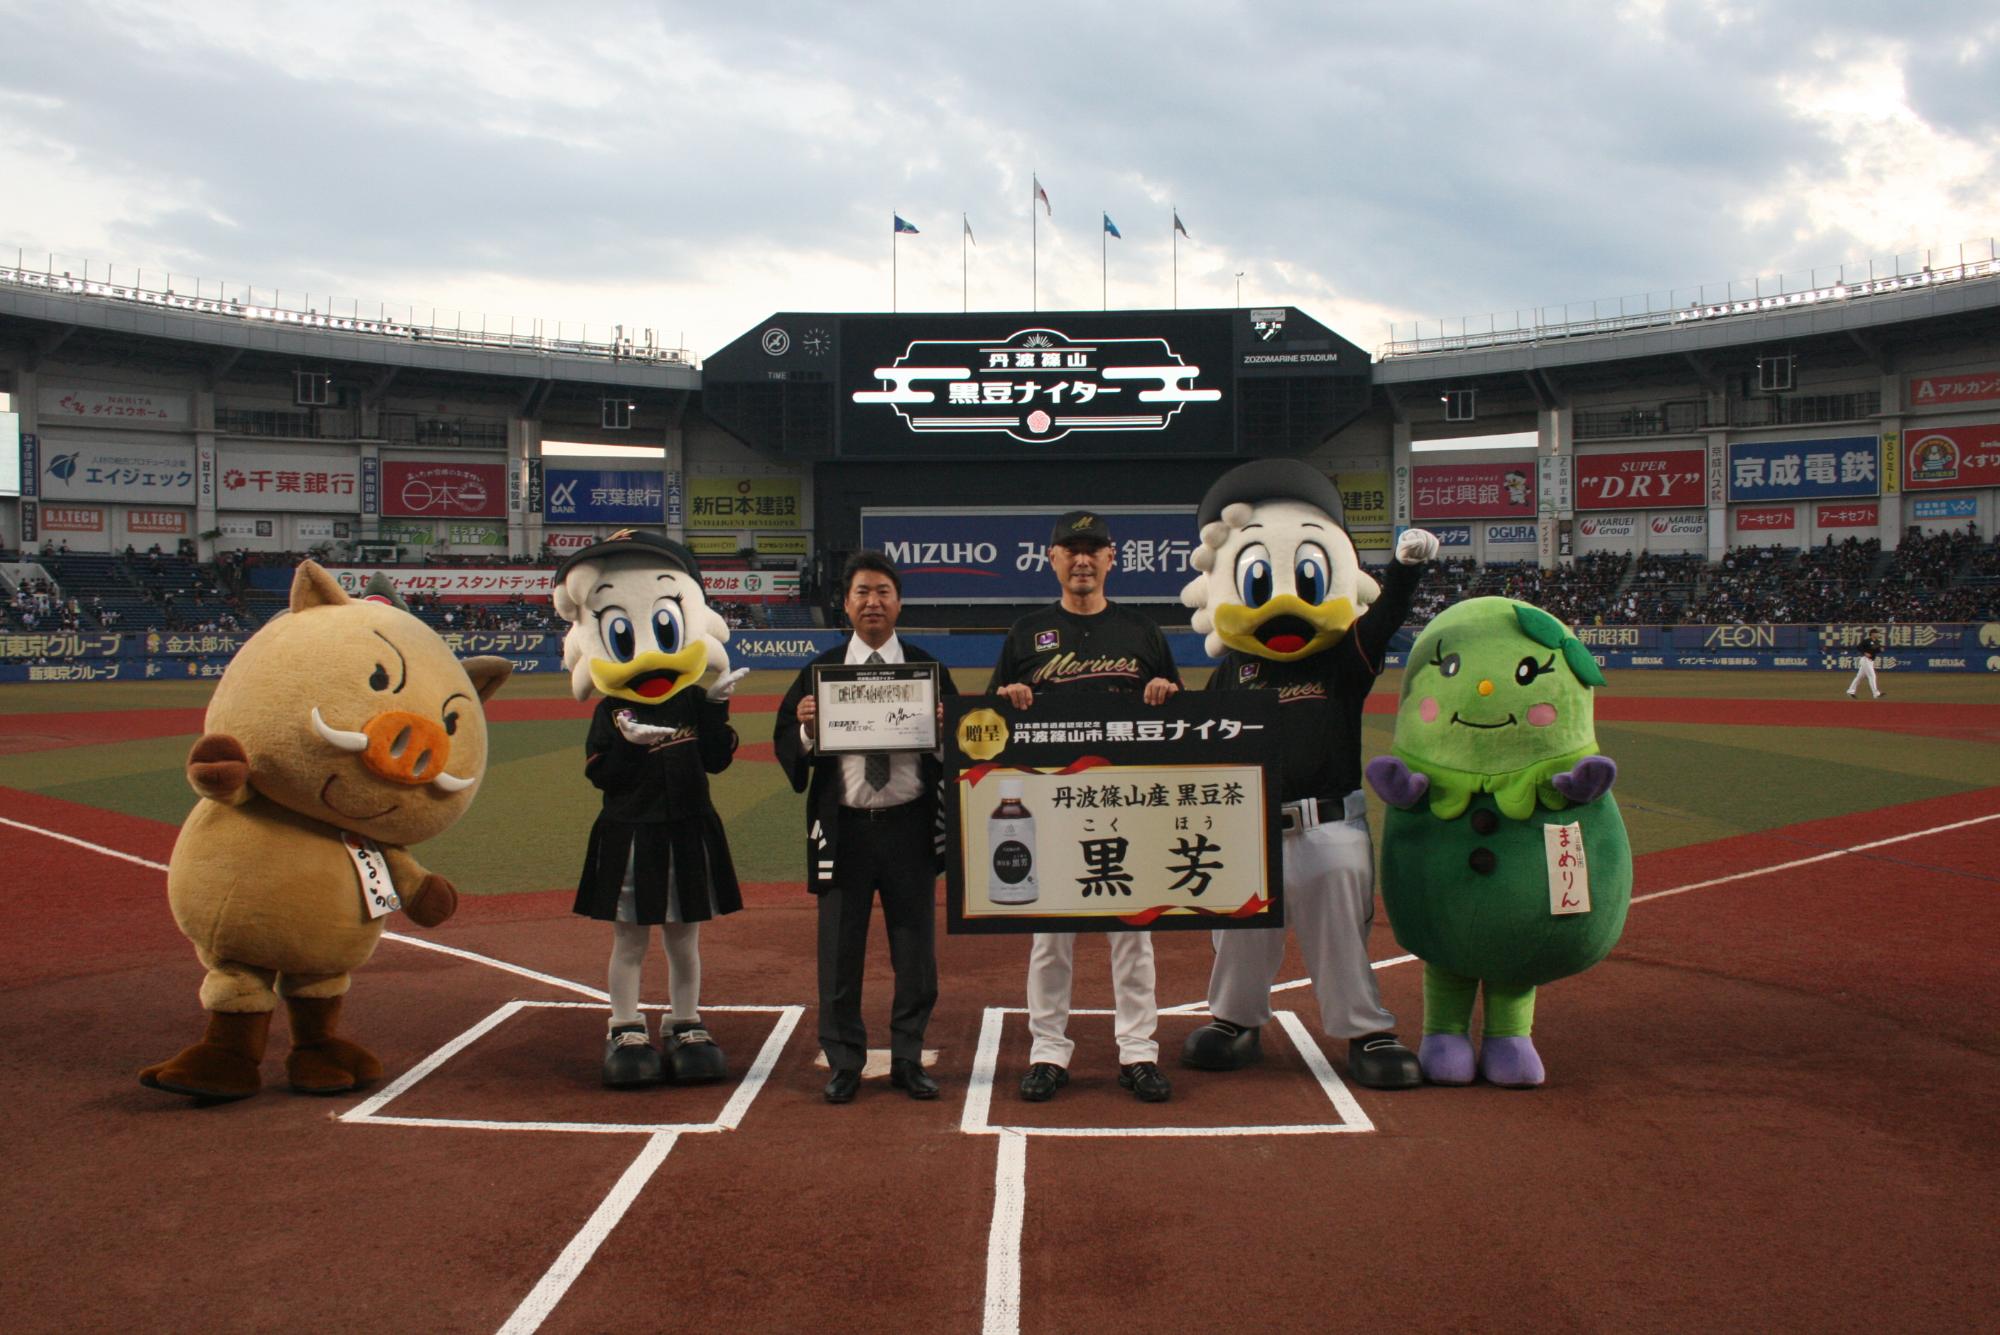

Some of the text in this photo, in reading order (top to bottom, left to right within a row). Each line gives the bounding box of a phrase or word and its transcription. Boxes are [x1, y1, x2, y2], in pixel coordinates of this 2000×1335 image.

[989, 353, 1087, 368] 丹波篠山
[1244, 354, 1338, 364] ZOZOMARINE STADIUM
[768, 371, 787, 380] TIME
[108, 396, 151, 405] NARITA
[948, 381, 1122, 406] 黒豆ナイター
[92, 405, 168, 418] ダイユウホーム
[1620, 460, 1667, 473] SUPER
[1733, 450, 1875, 488] 京成電鉄
[86, 468, 193, 487] エイジェック
[202, 461, 211, 494] HTS
[249, 470, 355, 495] 千葉銀行
[590, 488, 662, 507] 京葉銀行
[1416, 484, 1500, 506] ちば興銀
[551, 505, 576, 514] BANK
[692, 496, 796, 516] 新日本建設
[47, 510, 98, 523] B.I.TECH
[132, 512, 182, 525] B.I.TECH
[1596, 517, 1634, 526] MARUEI
[1739, 513, 1792, 525] アーキセプト
[1821, 510, 1875, 522] アーキセプト
[1489, 526, 1537, 538] OGURA
[1599, 526, 1630, 535] Group
[1671, 524, 1703, 534] Group
[1437, 530, 1469, 544] オグラ
[884, 541, 998, 566] MIZUHO
[1016, 539, 1191, 573] み銀行
[441, 633, 544, 651] 京インテリア
[1578, 628, 1639, 646] 新昭和
[753, 640, 816, 653] KAKUTA
[1033, 651, 1140, 684] Marines
[966, 724, 1000, 743] 贈呈
[1013, 729, 1103, 744] 丹波篠山市
[1105, 719, 1264, 742] 黒豆ナイター
[1052, 782, 1245, 809] 丹波篠山産 黒豆茶
[1558, 827, 1579, 908] まめりん
